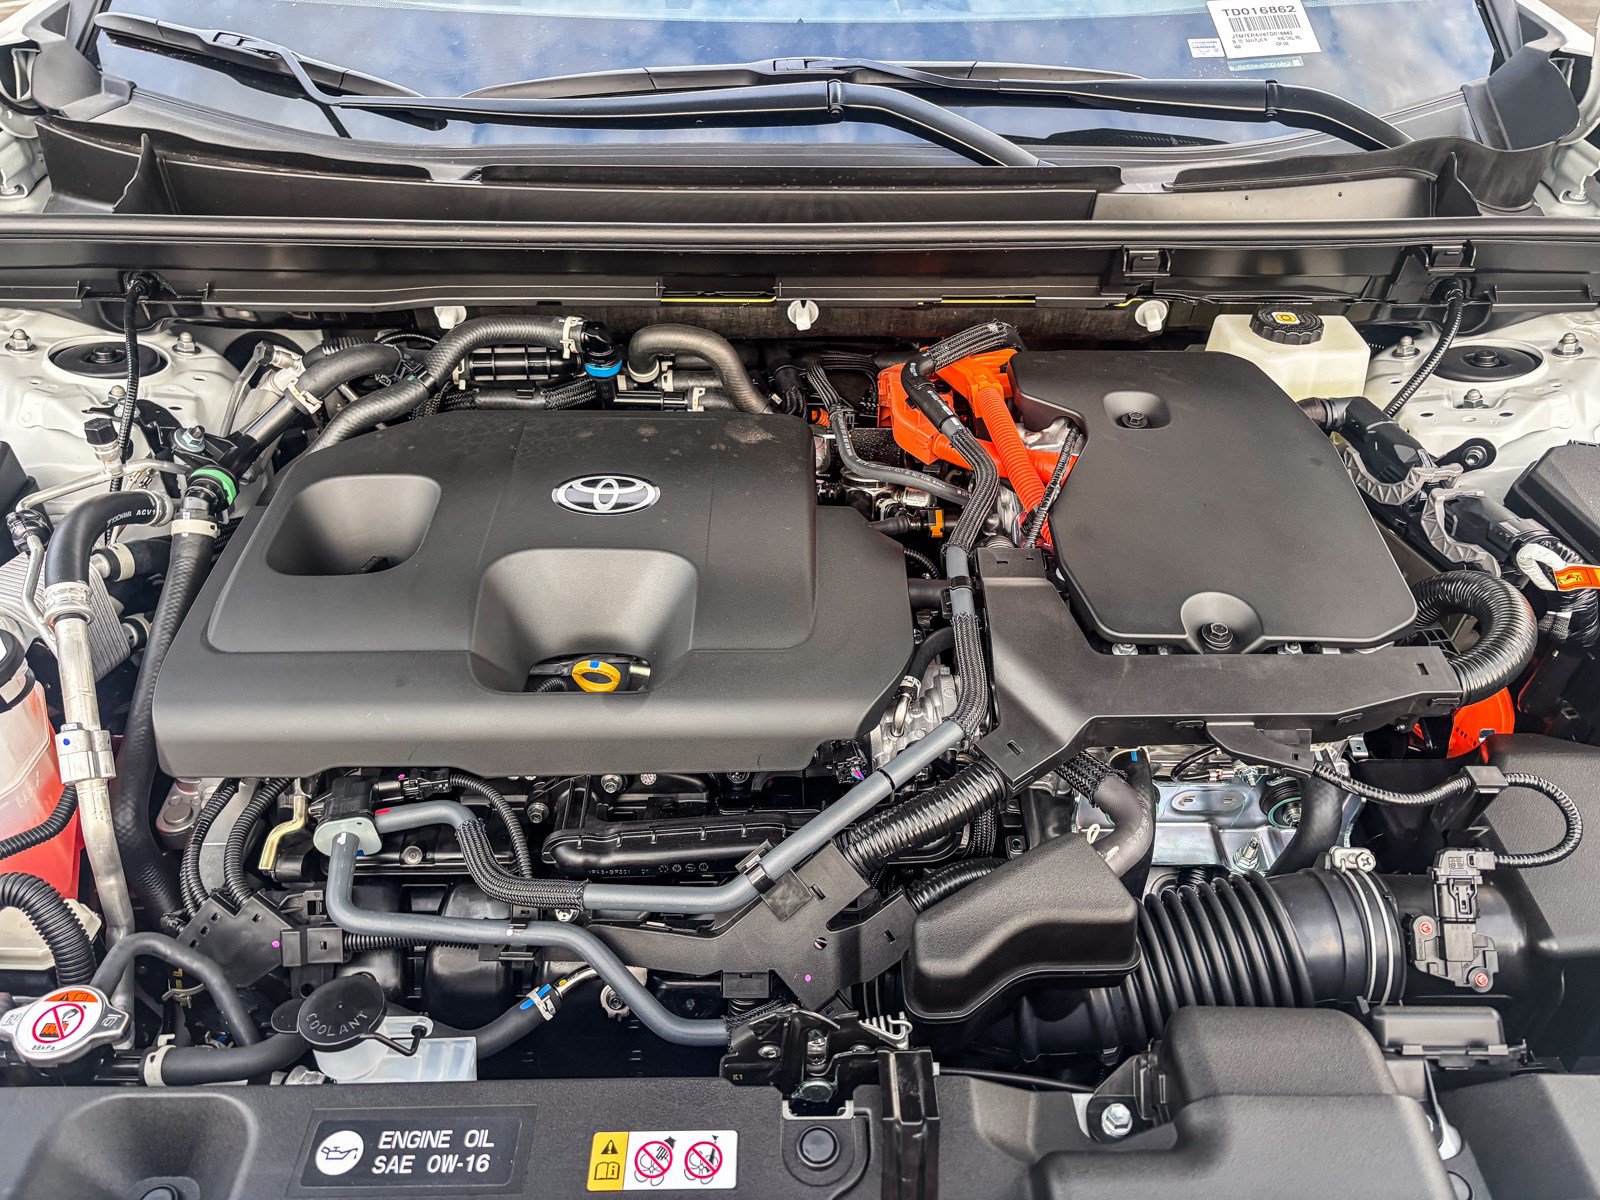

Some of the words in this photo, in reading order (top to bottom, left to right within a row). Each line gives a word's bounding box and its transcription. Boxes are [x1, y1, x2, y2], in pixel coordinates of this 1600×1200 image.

[1221, 5, 1297, 17] TD016862
[306, 1010, 368, 1037] COOLANT
[31, 1043, 56, 1052] 88kPa
[378, 1129, 453, 1149] ENGINE
[464, 1129, 495, 1148] OIL
[371, 1154, 416, 1174] SAE
